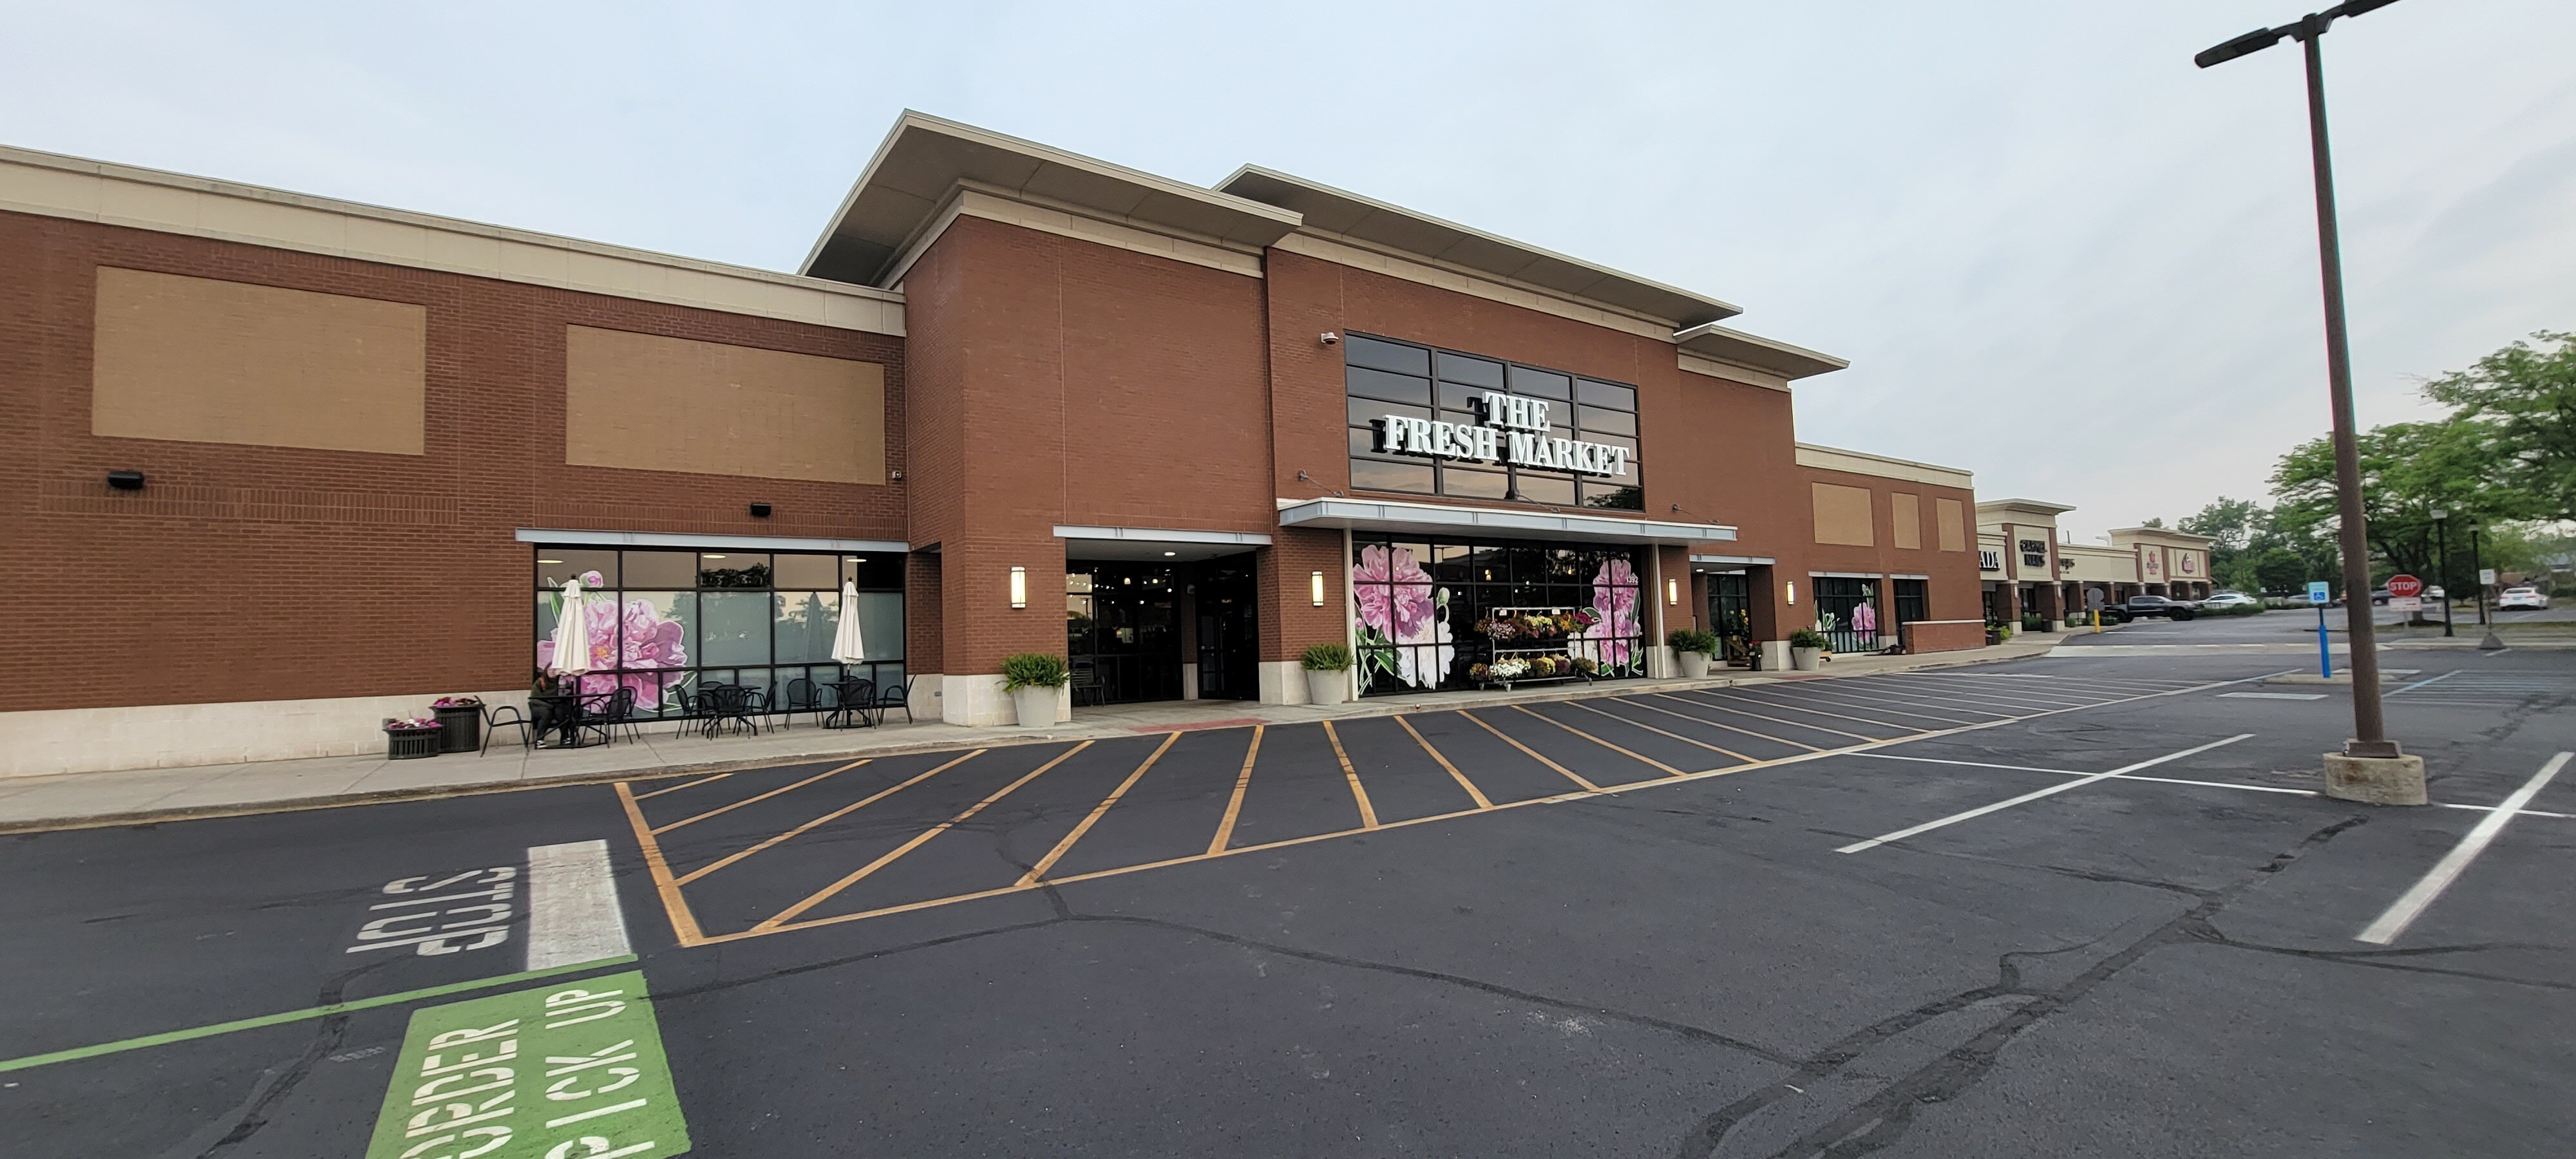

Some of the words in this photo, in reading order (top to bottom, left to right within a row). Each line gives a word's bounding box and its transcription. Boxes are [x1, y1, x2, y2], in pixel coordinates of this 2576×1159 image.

[1481, 391, 1551, 433] THE
[1383, 414, 1500, 461] FRESH
[1506, 430, 1630, 476] MARKET
[2390, 581, 2417, 591] STOP
[345, 867, 517, 956] STOP
[545, 989, 627, 1030] UP
[399, 1019, 519, 1159] ORDER
